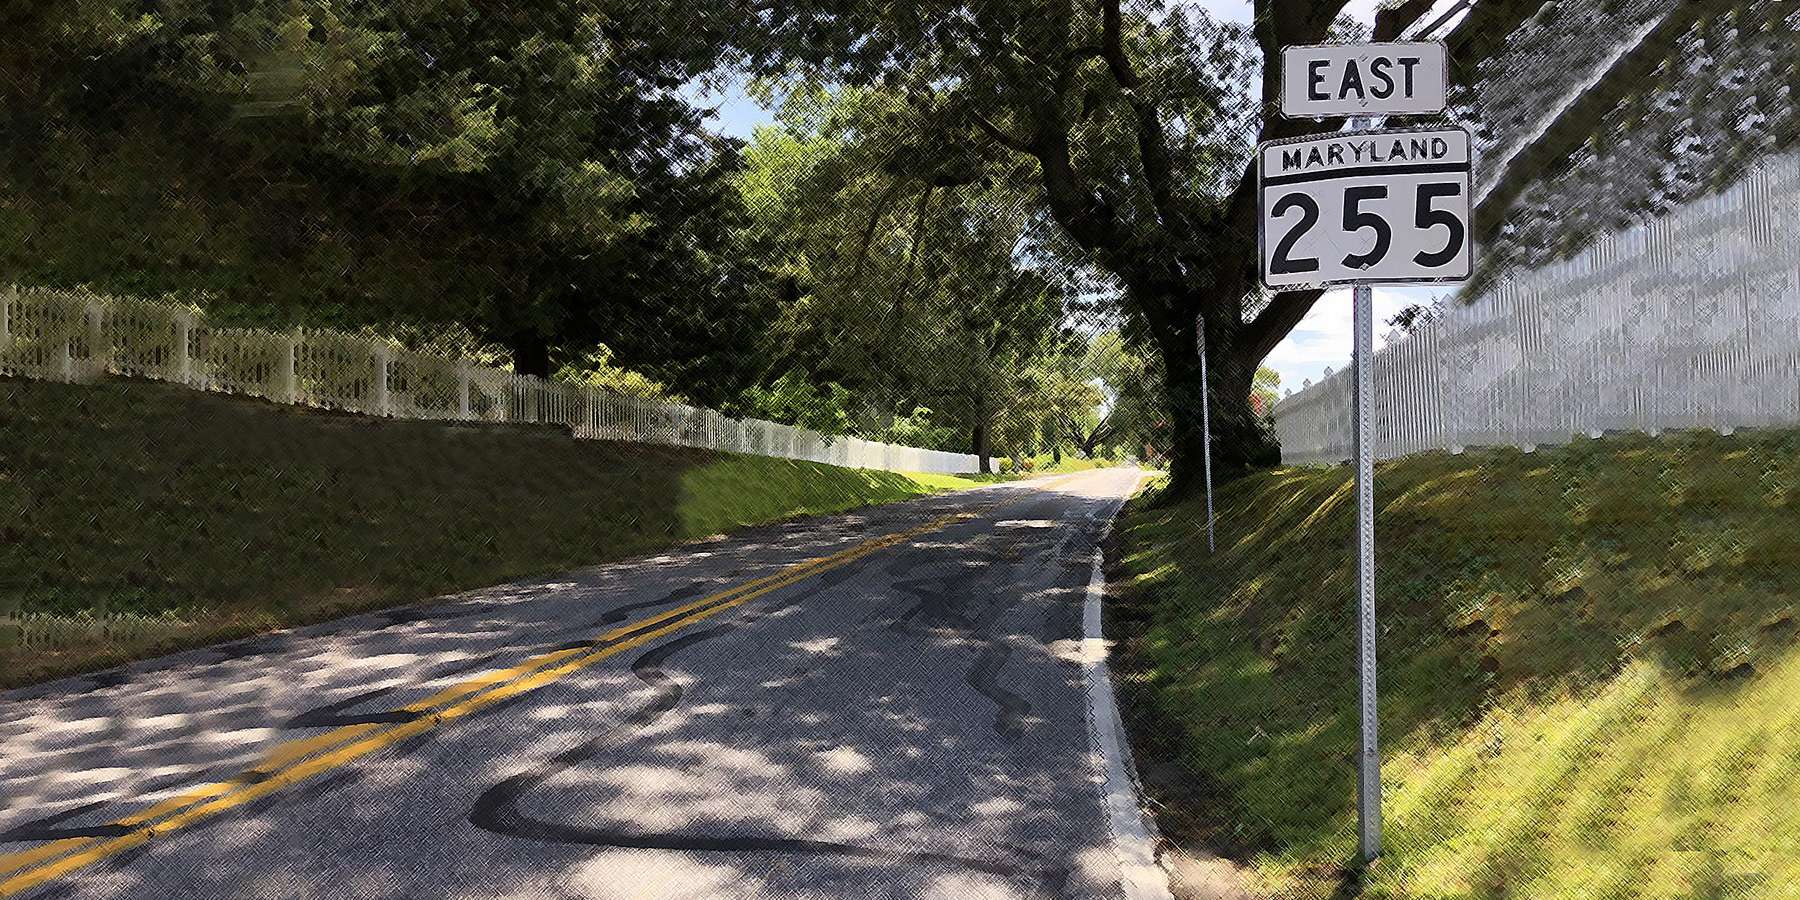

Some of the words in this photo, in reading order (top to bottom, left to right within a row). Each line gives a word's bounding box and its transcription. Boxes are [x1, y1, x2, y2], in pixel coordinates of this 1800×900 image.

[1308, 57, 1420, 101] EAST
[1282, 137, 1448, 171] MARYLAND
[1269, 182, 1465, 274] 255
